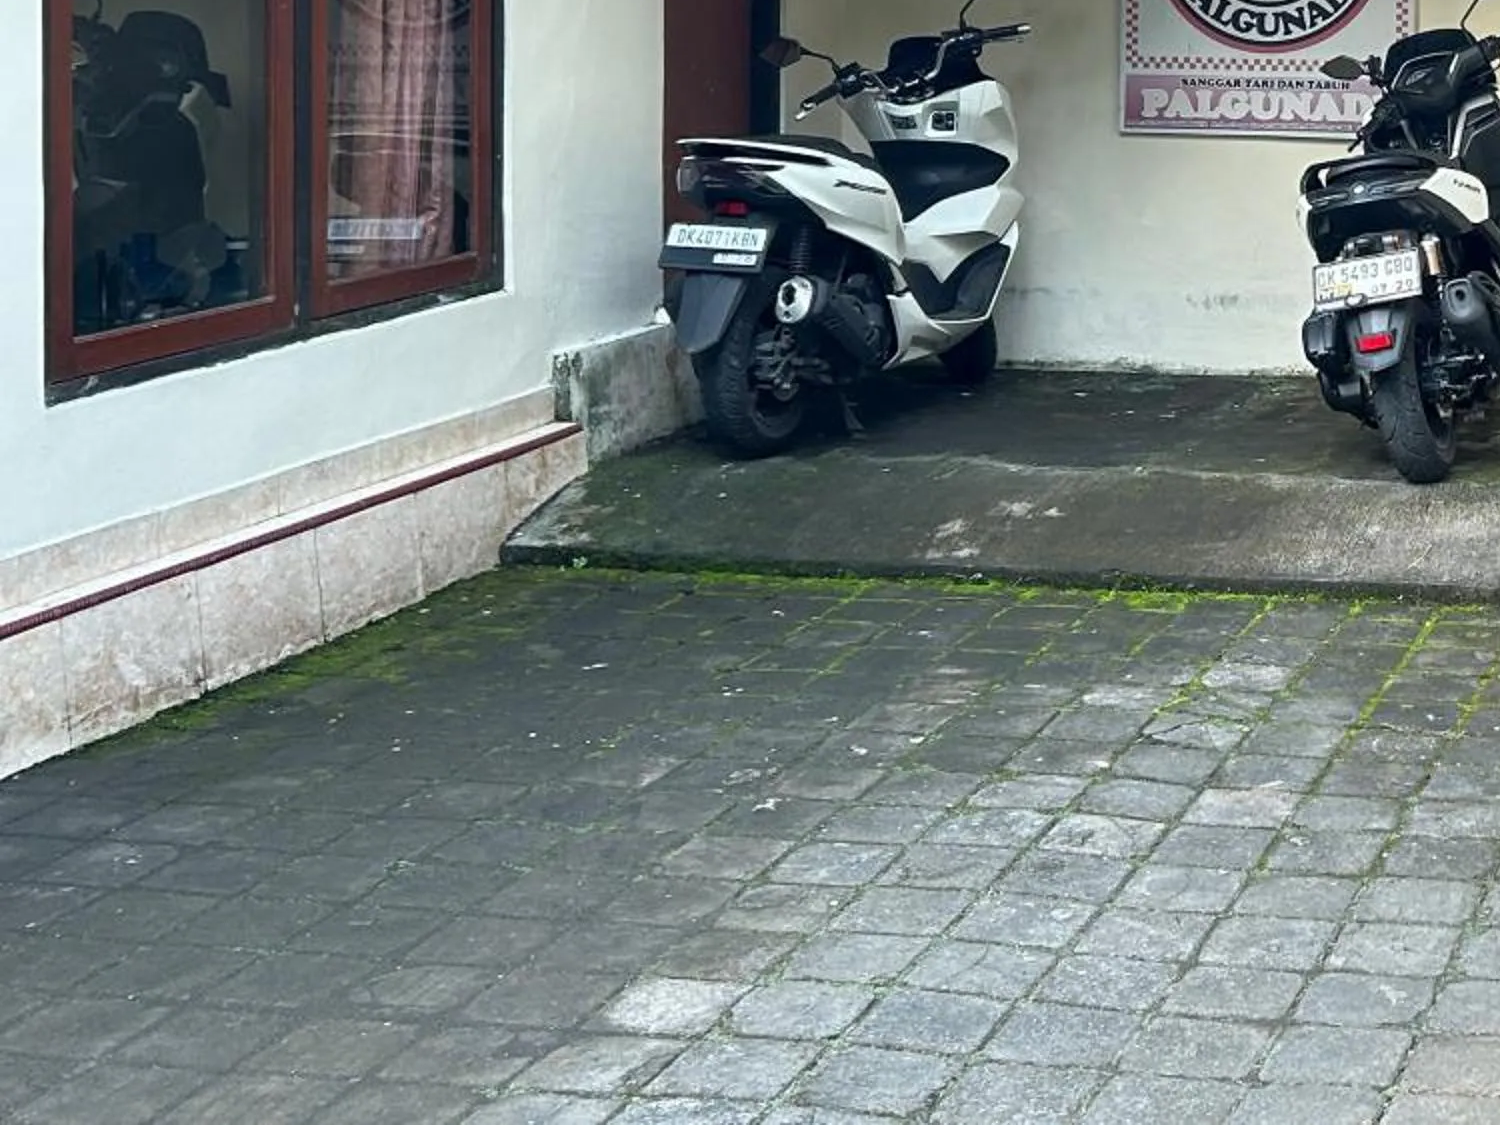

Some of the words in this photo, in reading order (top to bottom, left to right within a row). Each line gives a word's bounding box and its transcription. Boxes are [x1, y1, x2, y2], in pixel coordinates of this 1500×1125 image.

[1181, 78, 1241, 88] SANGGAR
[1278, 80, 1304, 89] DAN
[1140, 88, 1380, 122] PALGUNAD
